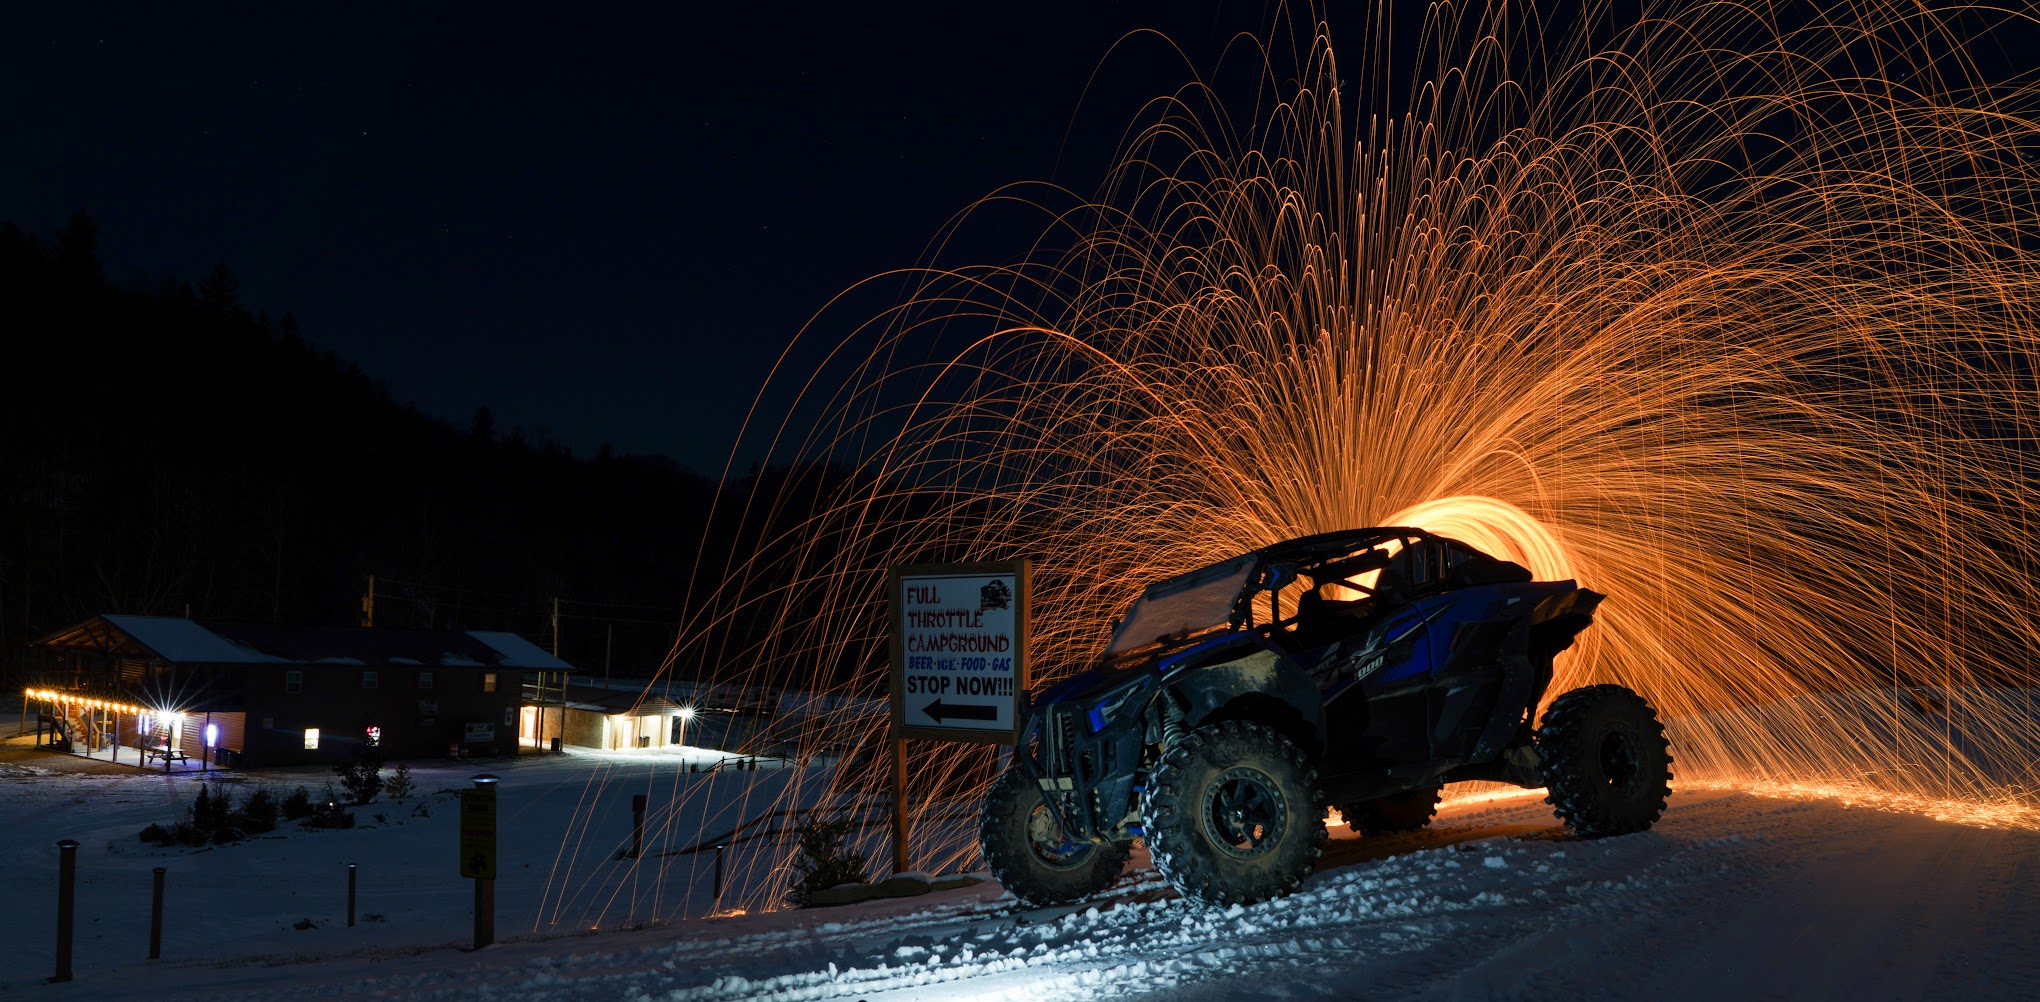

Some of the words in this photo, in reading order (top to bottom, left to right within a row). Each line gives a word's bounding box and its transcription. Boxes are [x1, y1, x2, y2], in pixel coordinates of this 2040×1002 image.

[907, 584, 940, 604] FULL
[907, 608, 983, 628] THROTTLE
[908, 632, 1010, 652] CAMPGROUND
[909, 656, 933, 670] BEER
[961, 657, 986, 671] FOOD
[992, 657, 1012, 672] GAS
[907, 676, 951, 694] STOP
[956, 676, 1014, 697] NOW!!!
